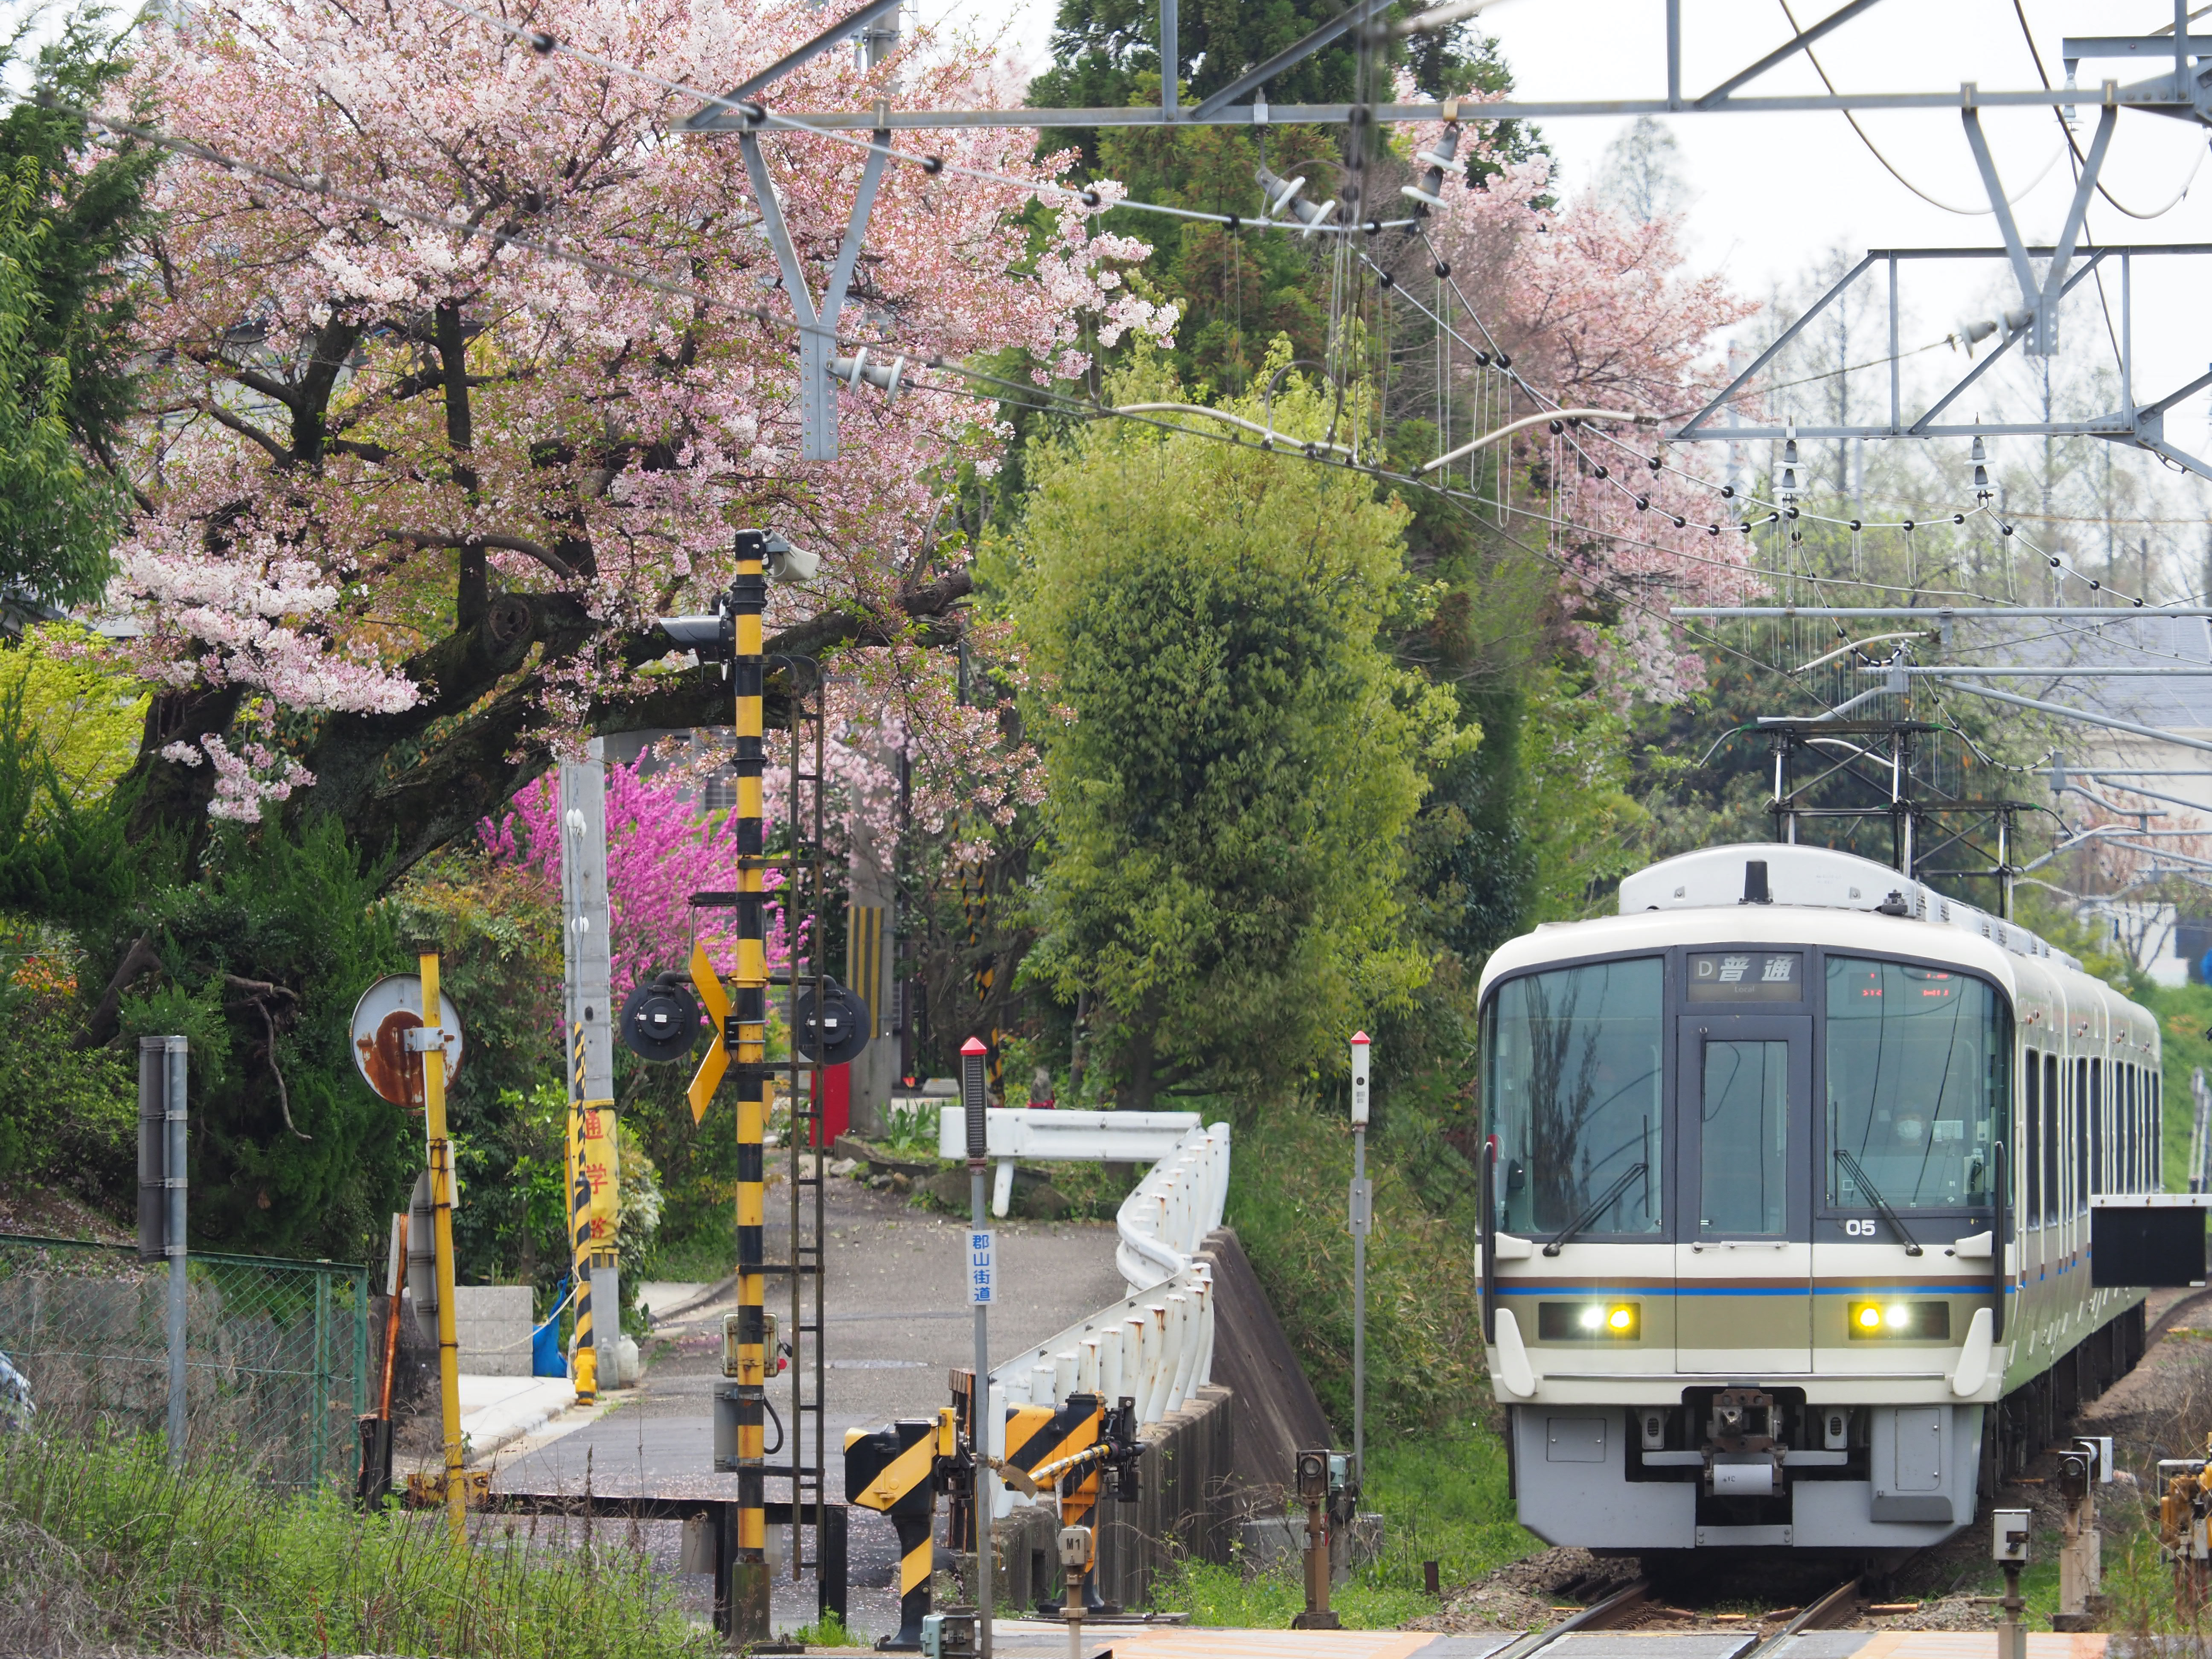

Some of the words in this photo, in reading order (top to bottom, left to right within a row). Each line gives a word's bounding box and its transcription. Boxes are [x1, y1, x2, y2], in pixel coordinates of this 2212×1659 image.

[1698, 960, 1713, 977] D
[1719, 956, 1793, 981] 普通
[1846, 1220, 1875, 1236] 05
[972, 1235, 990, 1301] 郡山街道
[1066, 1537, 1080, 1550] M1
